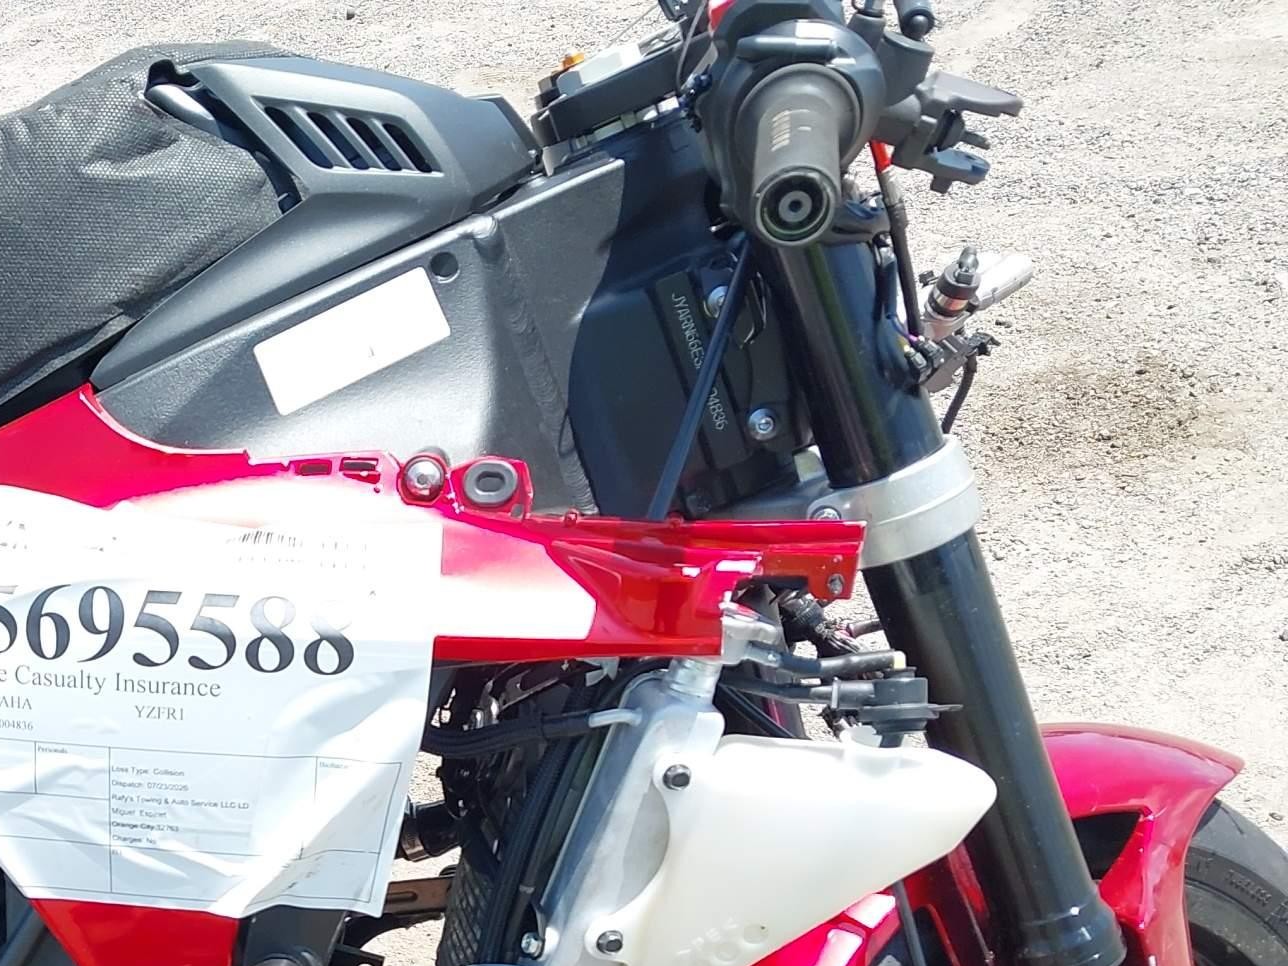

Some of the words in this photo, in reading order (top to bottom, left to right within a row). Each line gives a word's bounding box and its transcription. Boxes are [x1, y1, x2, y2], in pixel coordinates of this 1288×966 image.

[15, 663, 107, 696] Casualty
[115, 671, 222, 697] Insurance
[134, 704, 185, 721] YZFR1
[153, 767, 185, 777] Collision
[136, 796, 162, 805] Towing
[191, 800, 218, 808] Service
